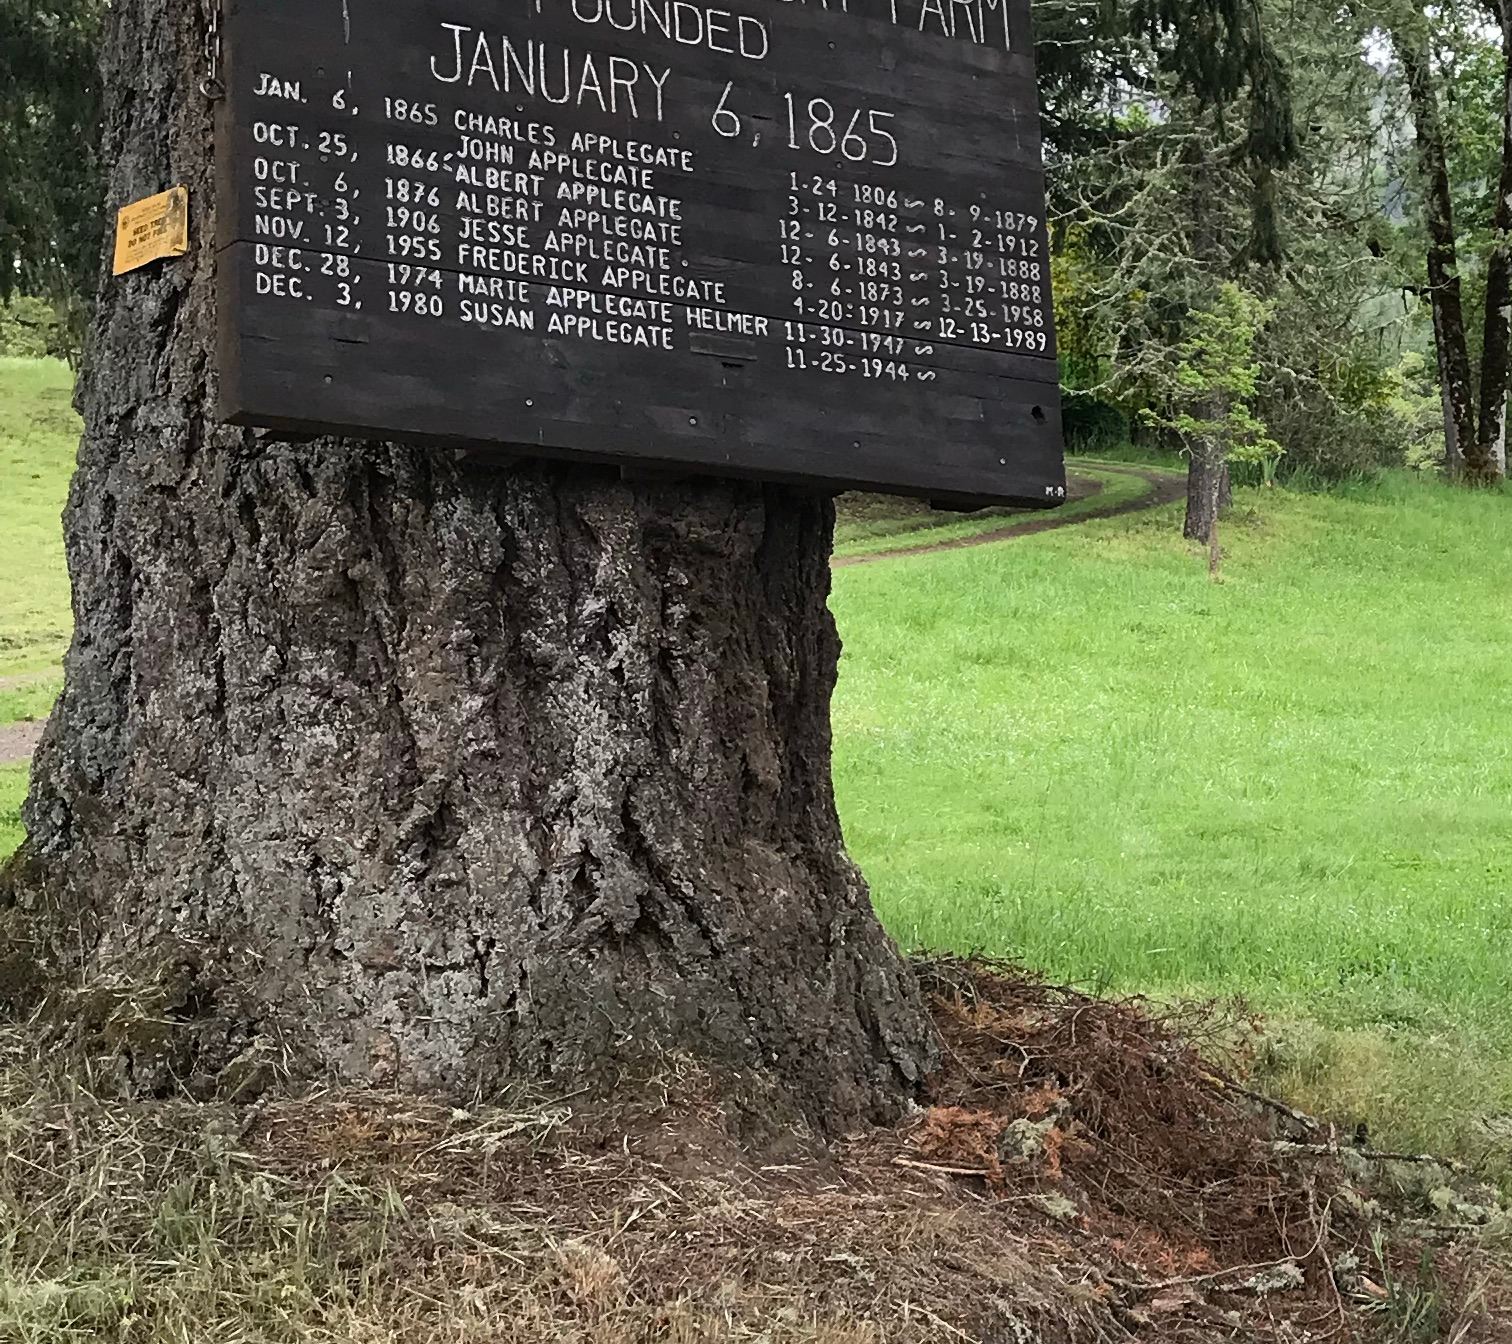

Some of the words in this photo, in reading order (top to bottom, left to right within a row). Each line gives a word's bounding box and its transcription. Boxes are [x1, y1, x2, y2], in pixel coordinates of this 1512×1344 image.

[253, 73, 307, 103] JAN.
[385, 97, 438, 126] 1865
[454, 110, 555, 146] CHARLES
[571, 132, 694, 171] APPLEGATE
[430, 22, 671, 121] JANUARY
[784, 93, 897, 166] 1865
[253, 122, 309, 149] OCT.
[318, 132, 358, 163] 25,
[457, 135, 514, 165] JOHN
[455, 165, 544, 196] ALBERT
[254, 158, 309, 186] OCT.
[385, 177, 440, 207] 1876
[456, 191, 543, 222] ALBERT
[558, 208, 681, 245] APPLEGATE
[254, 187, 324, 216] SEPT.
[387, 207, 440, 234] 1906
[459, 217, 530, 248] JESSE
[545, 231, 670, 270] APPLEGATE
[255, 215, 310, 243] NOV.
[325, 224, 360, 254] 12,
[387, 235, 441, 261] 1955
[458, 244, 588, 283] FREDERICK
[602, 266, 726, 303] APPLEGATE
[255, 244, 310, 271] DEC.
[321, 253, 360, 284] 28,
[388, 263, 443, 289] 1974
[458, 274, 530, 302] MARIE
[546, 287, 673, 323] APPLEGATE
[687, 307, 768, 336] HELMER
[256, 273, 312, 300] DEC.
[388, 291, 443, 316] 1980
[460, 300, 534, 330] SUSAN
[548, 314, 674, 349] APPLEGATE
